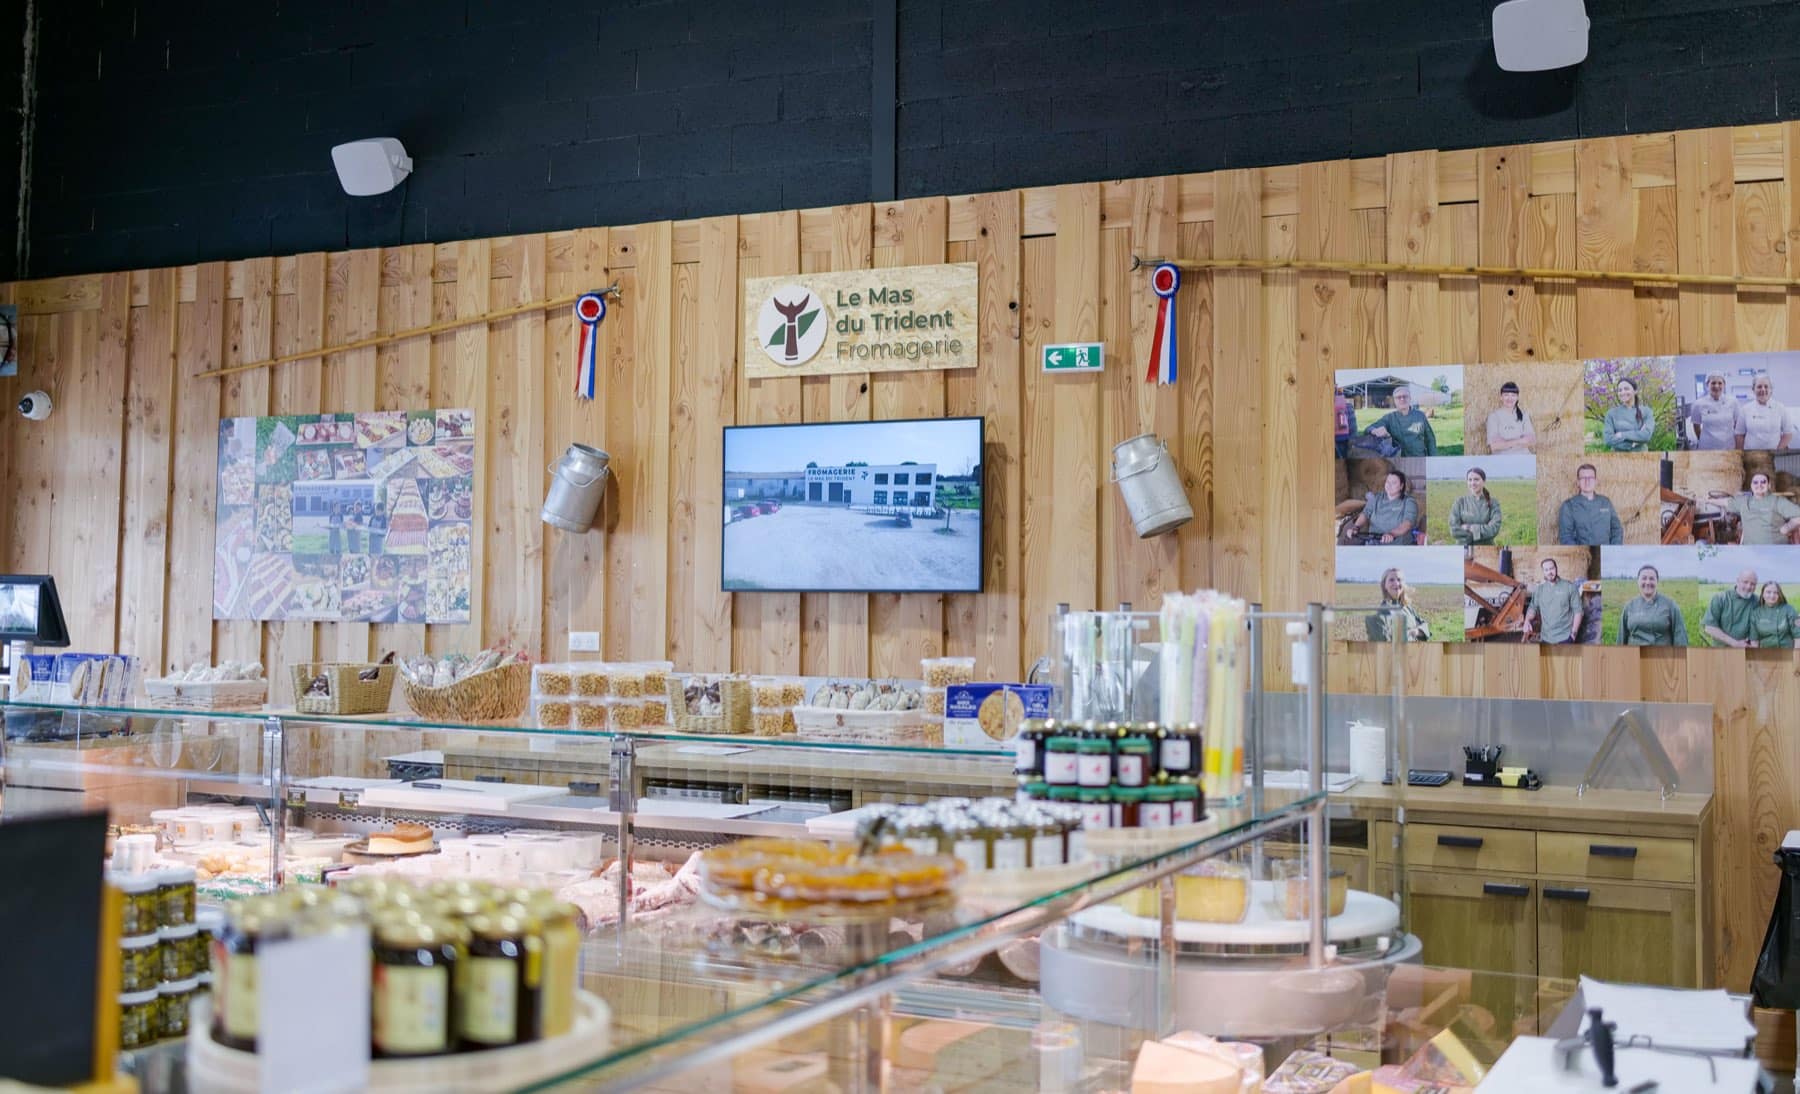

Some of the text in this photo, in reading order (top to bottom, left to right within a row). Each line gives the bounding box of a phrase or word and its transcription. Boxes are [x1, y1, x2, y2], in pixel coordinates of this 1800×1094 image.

[837, 287, 913, 307] Le Mas
[836, 310, 953, 333] du Trident
[837, 333, 962, 360] Fromagerie
[808, 468, 856, 476] FROMAGERIE
